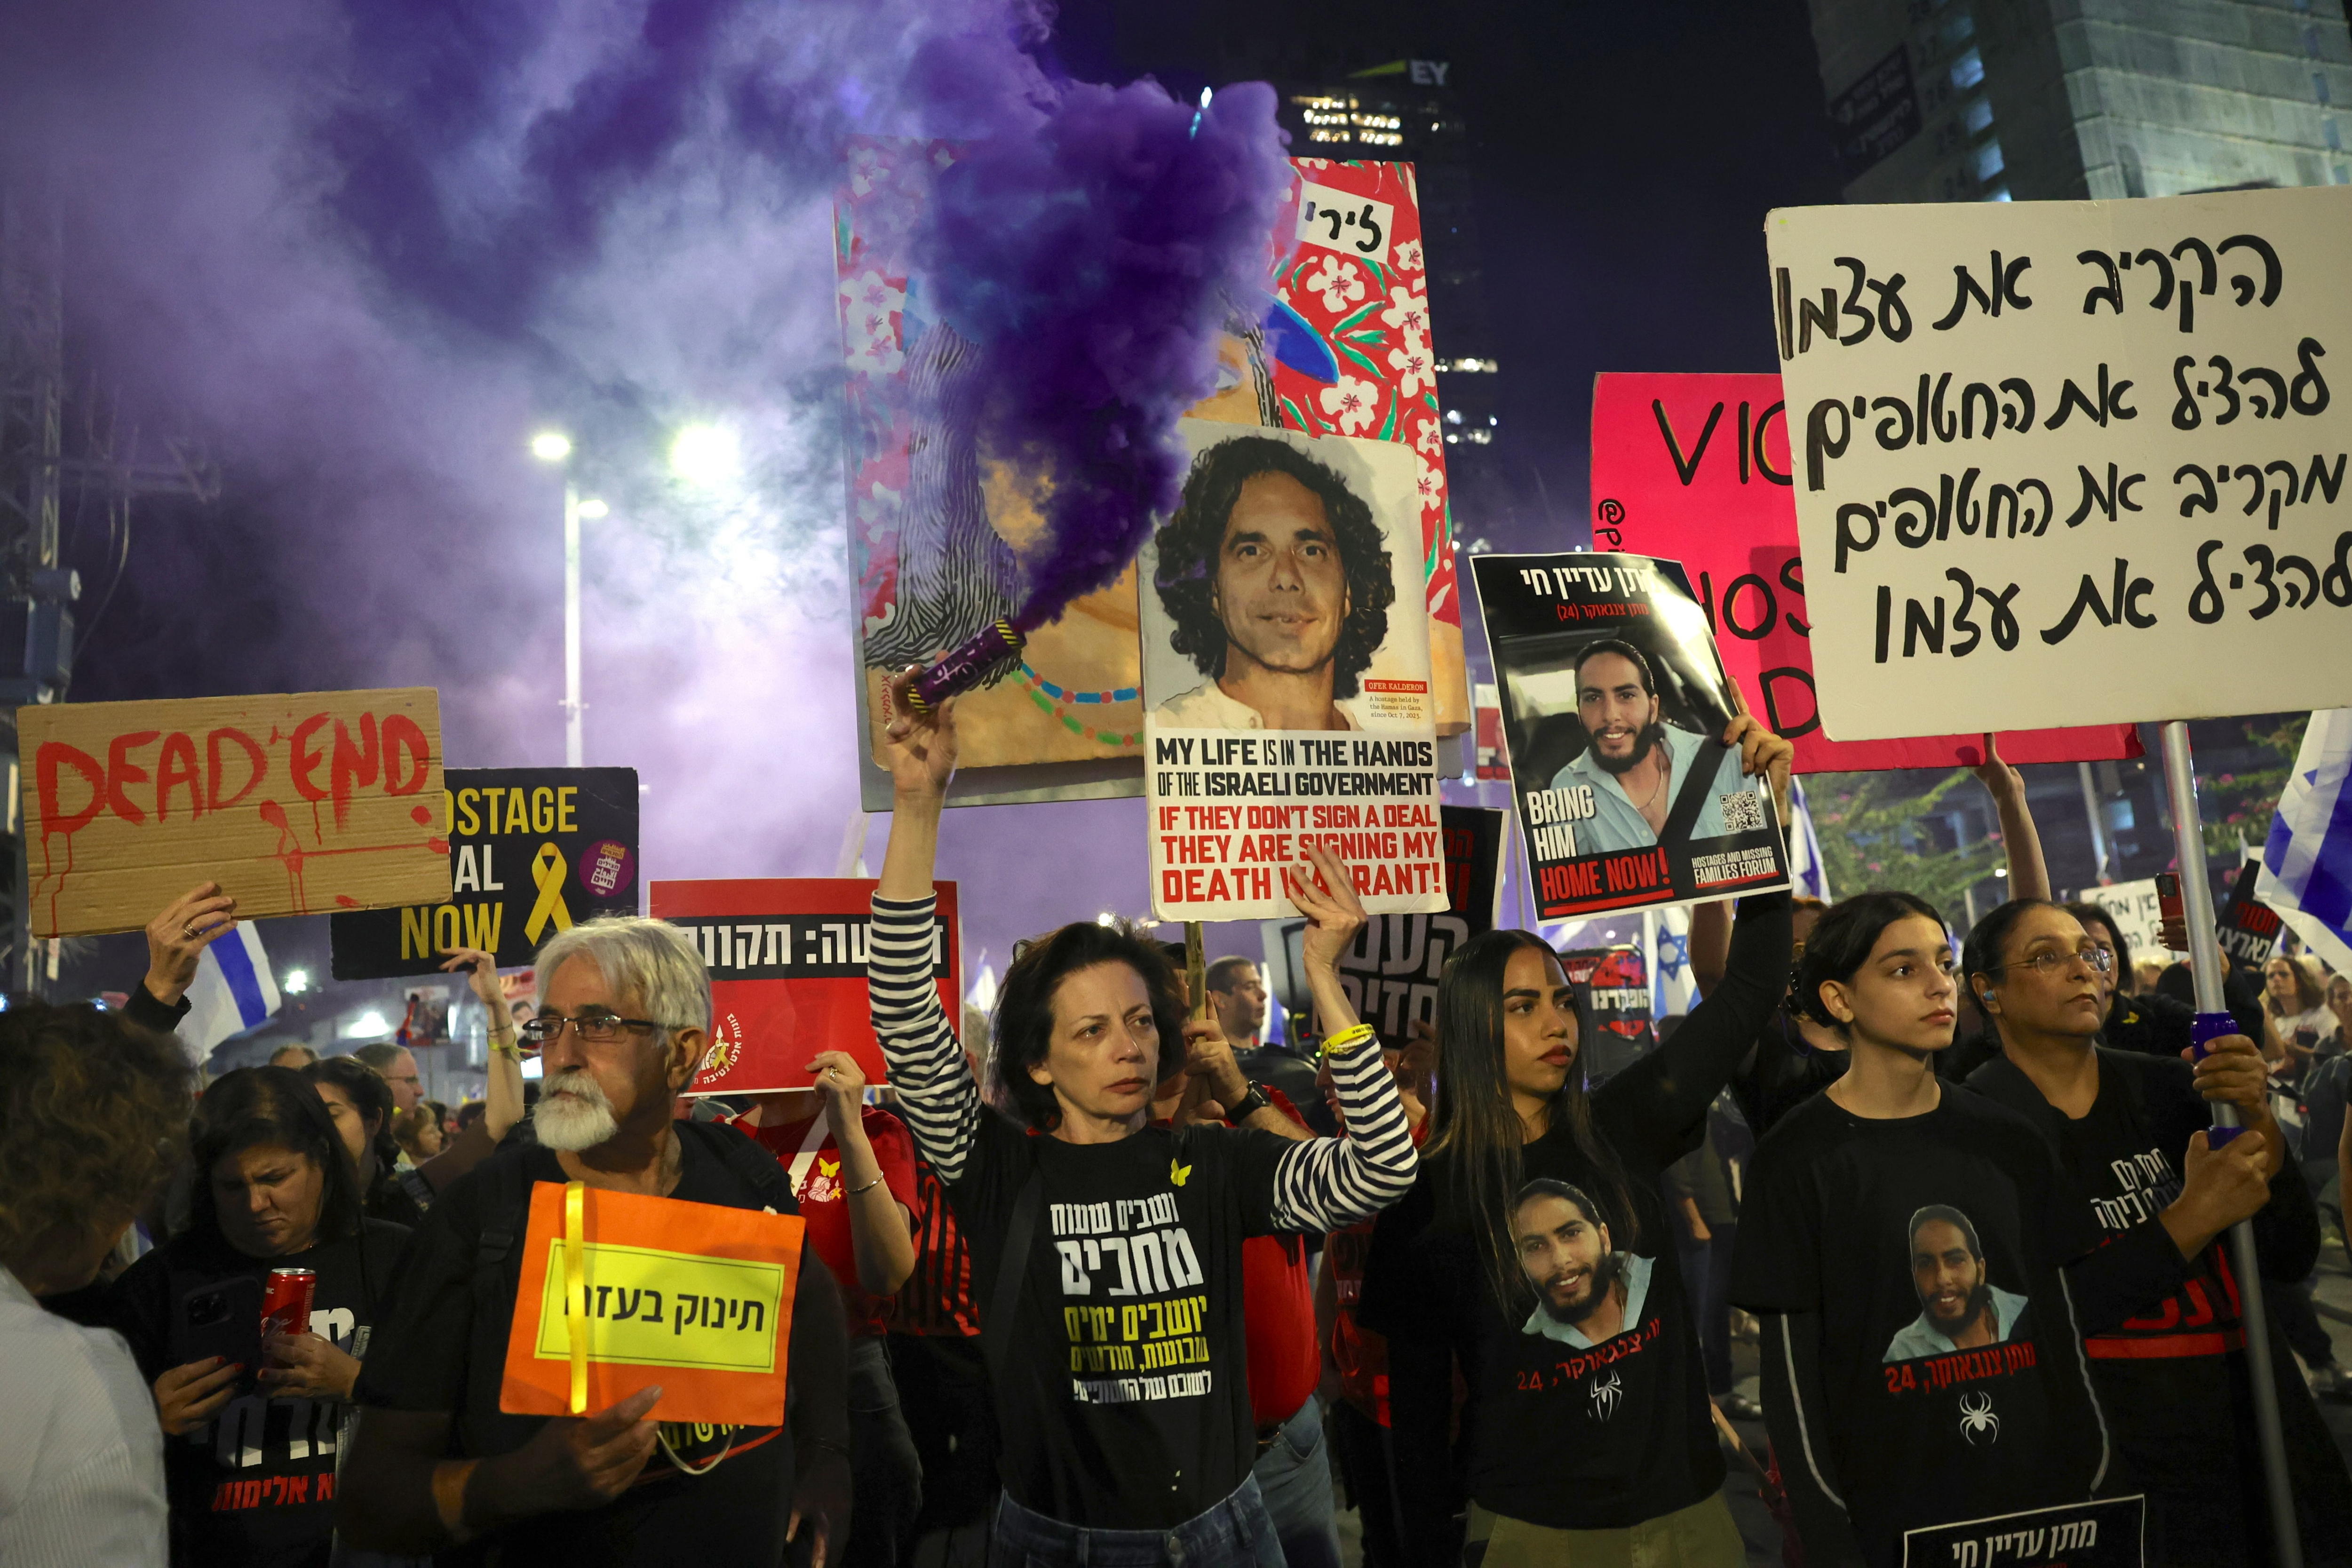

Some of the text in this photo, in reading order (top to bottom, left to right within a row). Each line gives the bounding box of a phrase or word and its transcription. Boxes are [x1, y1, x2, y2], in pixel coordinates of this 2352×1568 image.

[1410, 60, 1449, 86] EY
[1776, 234, 2283, 360] הקריב את עצמו
[1806, 336, 2331, 492] להציל את החטופים
[1835, 454, 2347, 574] מקריב את החטופים
[1520, 569, 1552, 596] חי
[1553, 567, 1612, 600] עדיין
[1875, 531, 2352, 664] להציל את עצמו
[1557, 603, 1580, 621] (24)
[1627, 603, 1649, 617] מתן
[1156, 738, 1433, 767] MY LIFE IS IN THE HANDS
[36, 711, 429, 834] DEAD END
[1158, 772, 1434, 796] OF THE ISRAELI GOVERNMENT
[1159, 804, 1438, 830] IF THEY DON'T SIGN A DEAL
[1527, 784, 1595, 825] BRING
[1160, 835, 1232, 864] THEY
[1238, 834, 1293, 862] ARE
[1299, 832, 1397, 861] SIGNING
[1404, 832, 1438, 858] MY
[1533, 824, 1577, 862] HIM
[1692, 846, 1773, 868] HOSTAGES AND MISSING
[593, 876, 613, 887] חיים
[1162, 868, 1271, 903] DEATH
[1540, 847, 1670, 901] HOME NOW!
[1694, 857, 1776, 884] FAMILIES FORUM
[401, 902, 502, 960] NOW
[1054, 1228, 1204, 1296] מחכים
[675, 1295, 764, 1335] תינוק
[1065, 1296, 1207, 1341] יושבים ימים
[1071, 1345, 1135, 1372] חודשים
[2003, 1342, 2037, 1376] מתן
[1138, 1376, 1167, 1401] של
[1517, 1371, 1543, 1392] 24
[1885, 1365, 1916, 1393] 24
[1952, 1520, 2097, 1568] מתן עדיין חי
